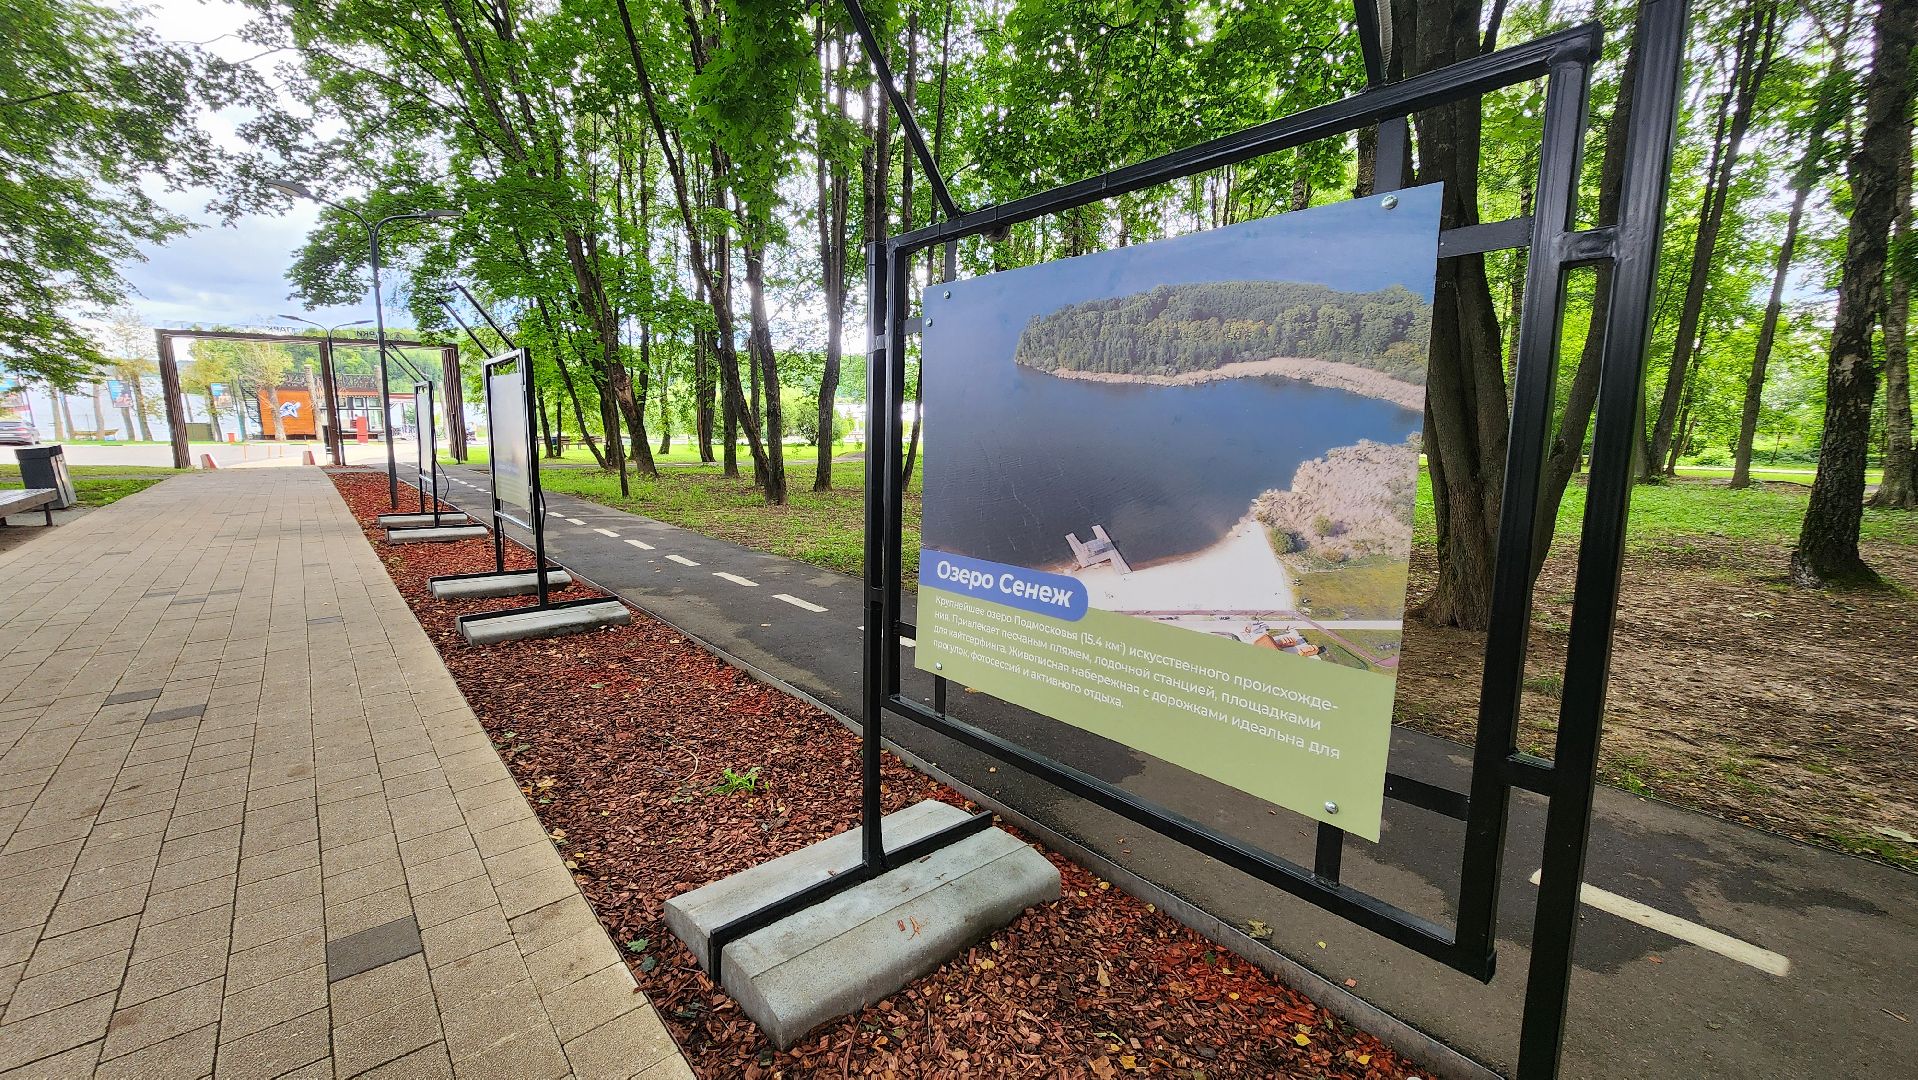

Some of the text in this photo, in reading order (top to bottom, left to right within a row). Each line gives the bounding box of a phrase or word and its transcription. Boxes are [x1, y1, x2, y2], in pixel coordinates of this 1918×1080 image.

[937, 561, 1073, 608] Озеро Сенеж
[933, 640, 1124, 708] прогулок, фотосессий и активного отдыха.
[933, 625, 948, 634] для
[1009, 646, 1069, 672] Живописная
[1071, 666, 1140, 695] набережная
[1143, 689, 1149, 697] с
[1152, 691, 1227, 723] дорожками
[1231, 716, 1304, 748] идеальна
[1309, 741, 1340, 760] для
[935, 611, 1321, 731] ния. Привлекает песчаным пляжем, лодочной станцией, площадками
[936, 595, 985, 616] Крупнейшее
[987, 609, 1012, 622] озеро
[1014, 615, 1078, 641] Подмосковья
[1081, 632, 1102, 647] (15.4
[1129, 647, 1230, 682] искусственного
[1234, 675, 1339, 711] происхожде-
